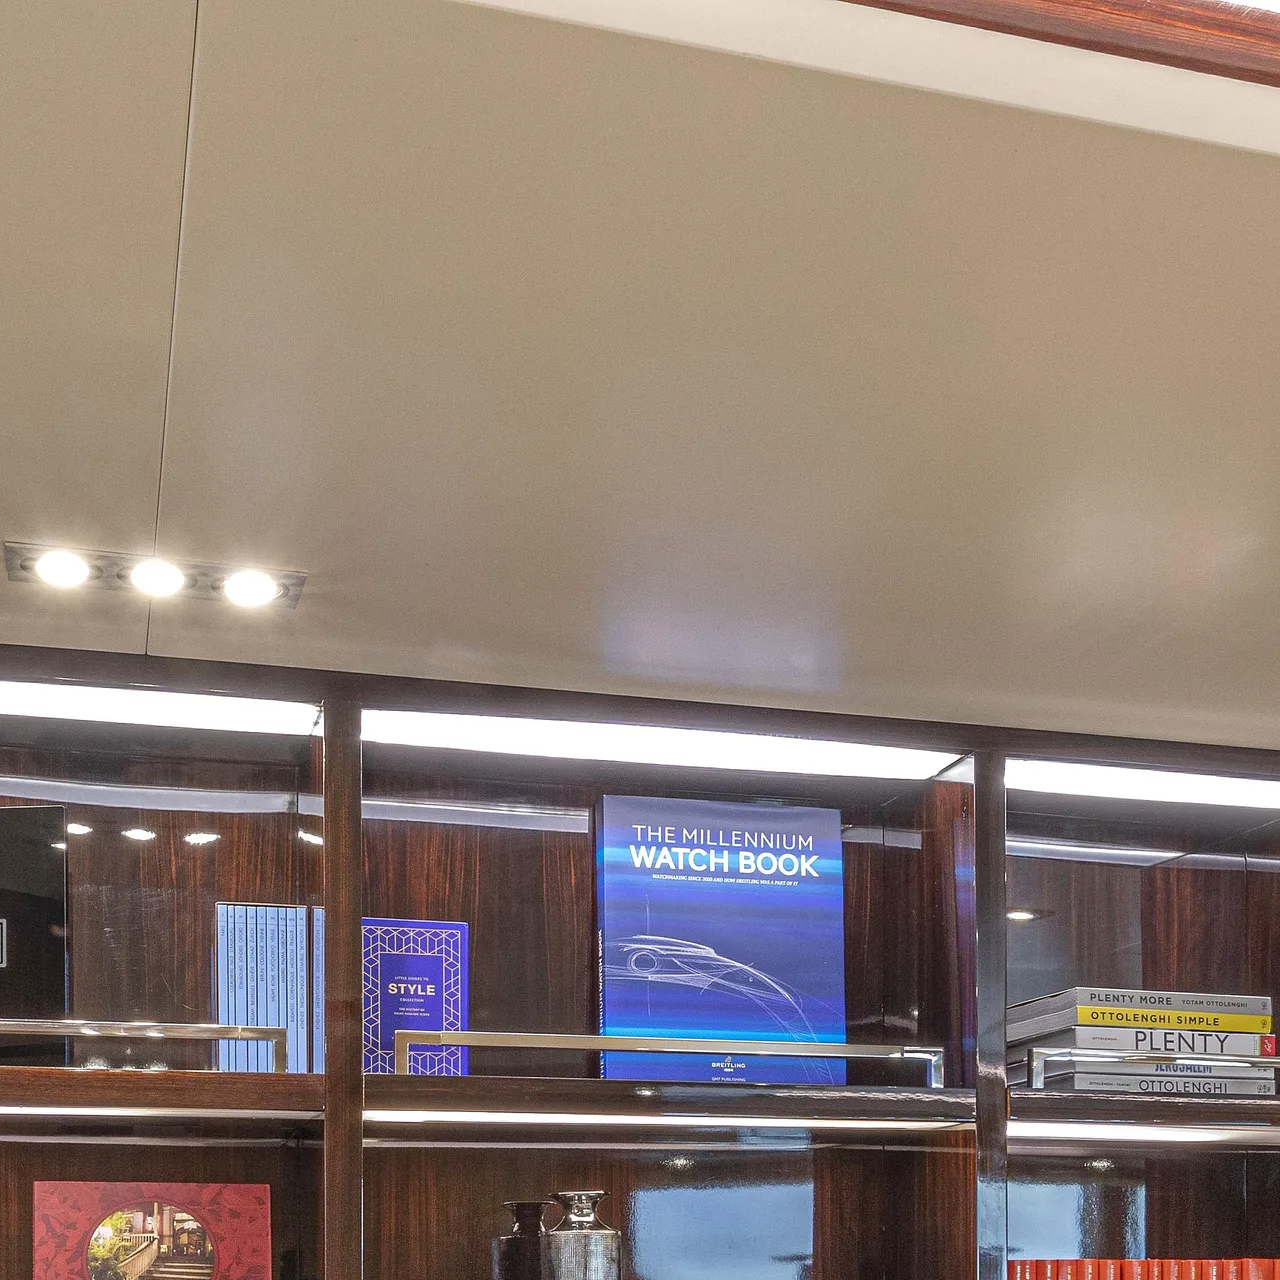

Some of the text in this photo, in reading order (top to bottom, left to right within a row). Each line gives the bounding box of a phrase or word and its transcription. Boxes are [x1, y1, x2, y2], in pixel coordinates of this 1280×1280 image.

[632, 824, 814, 851] THE MILLENNIUM
[629, 845, 820, 878] WATCH BOOK
[388, 983, 436, 996] STYLE
[1090, 993, 1173, 1006] PLENTY MORE
[1206, 1000, 1248, 1008] OTTOLENGHI
[1091, 1012, 1220, 1026] OTTOLENGHI SIMPLE
[1135, 1030, 1230, 1054] PLENTY
[1138, 1080, 1228, 1094] OTTOLENGHI
